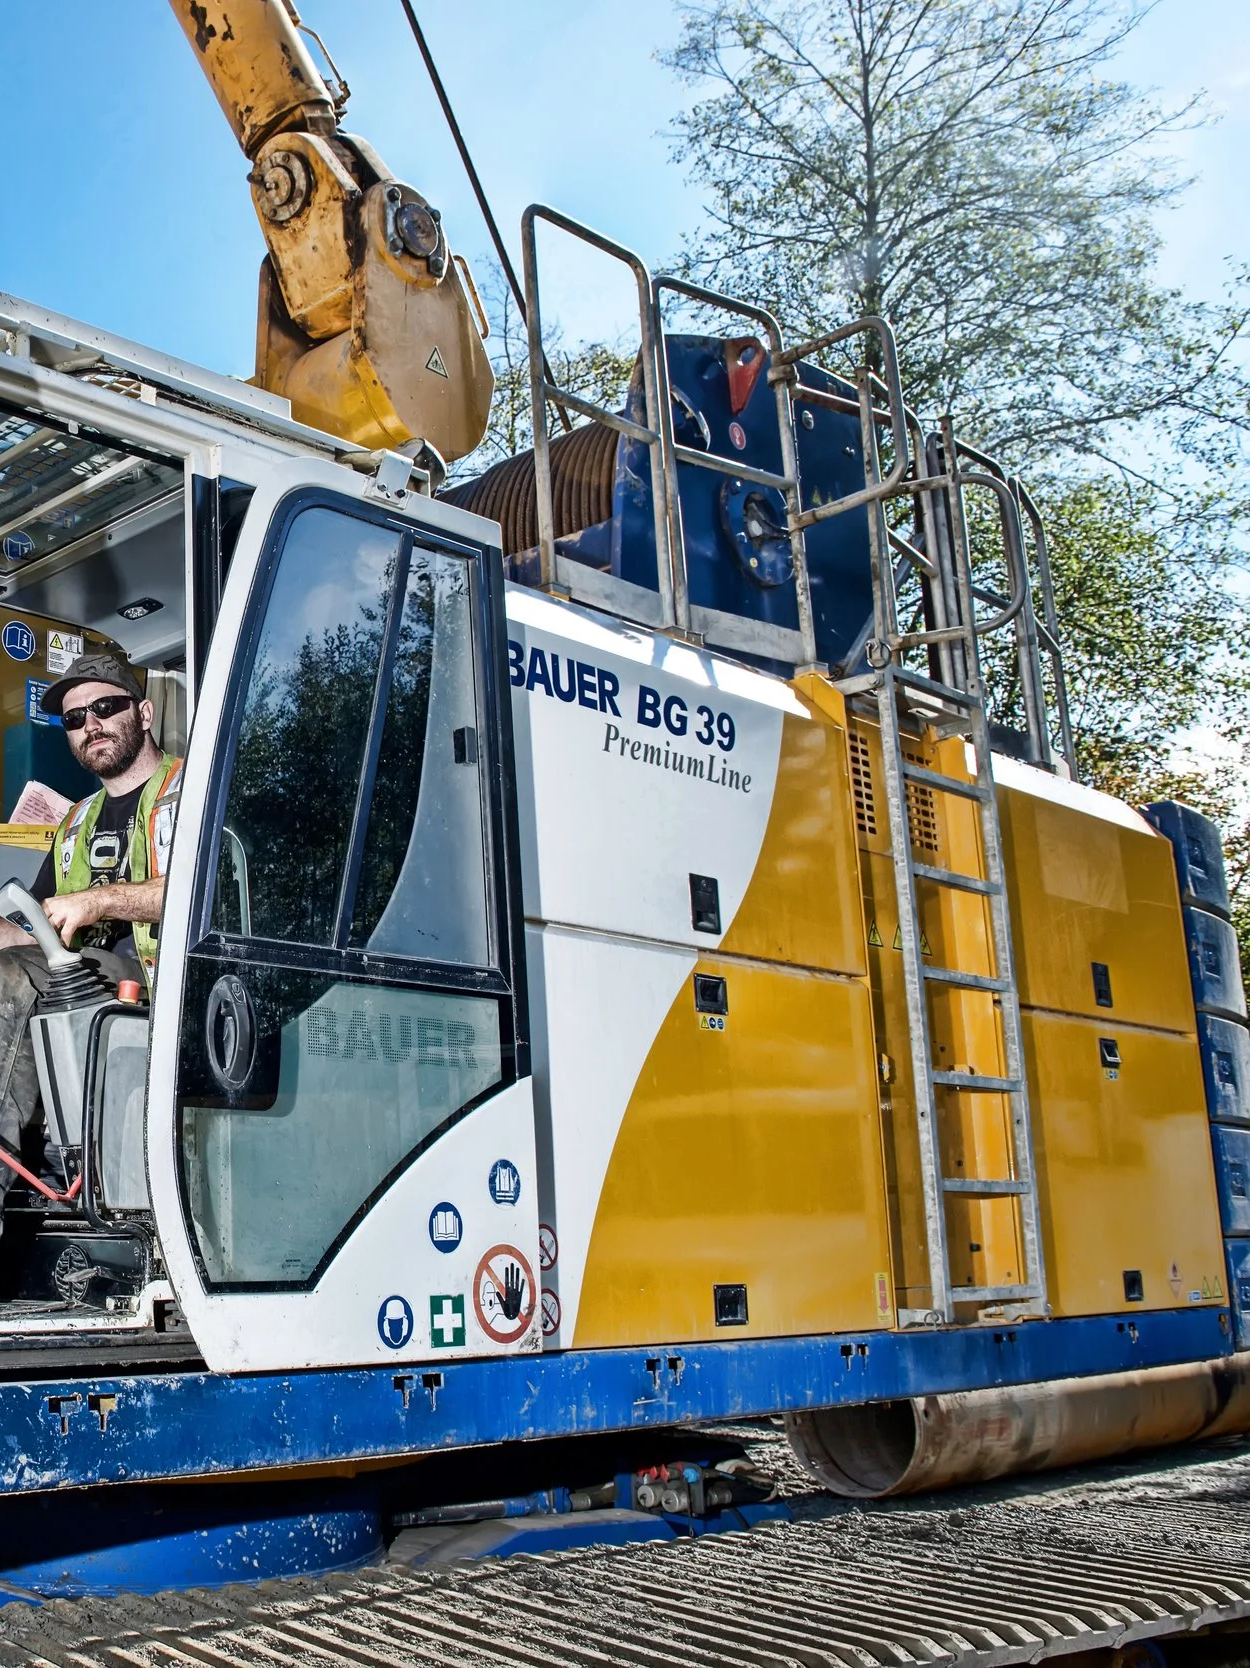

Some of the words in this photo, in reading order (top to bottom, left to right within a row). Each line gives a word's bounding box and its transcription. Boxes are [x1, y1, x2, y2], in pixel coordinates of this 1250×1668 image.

[507, 638, 623, 719] BAUER
[636, 683, 689, 737] BG
[694, 704, 736, 752] 39
[601, 722, 752, 793] PremiumLine
[307, 1006, 479, 1069] BAUER
